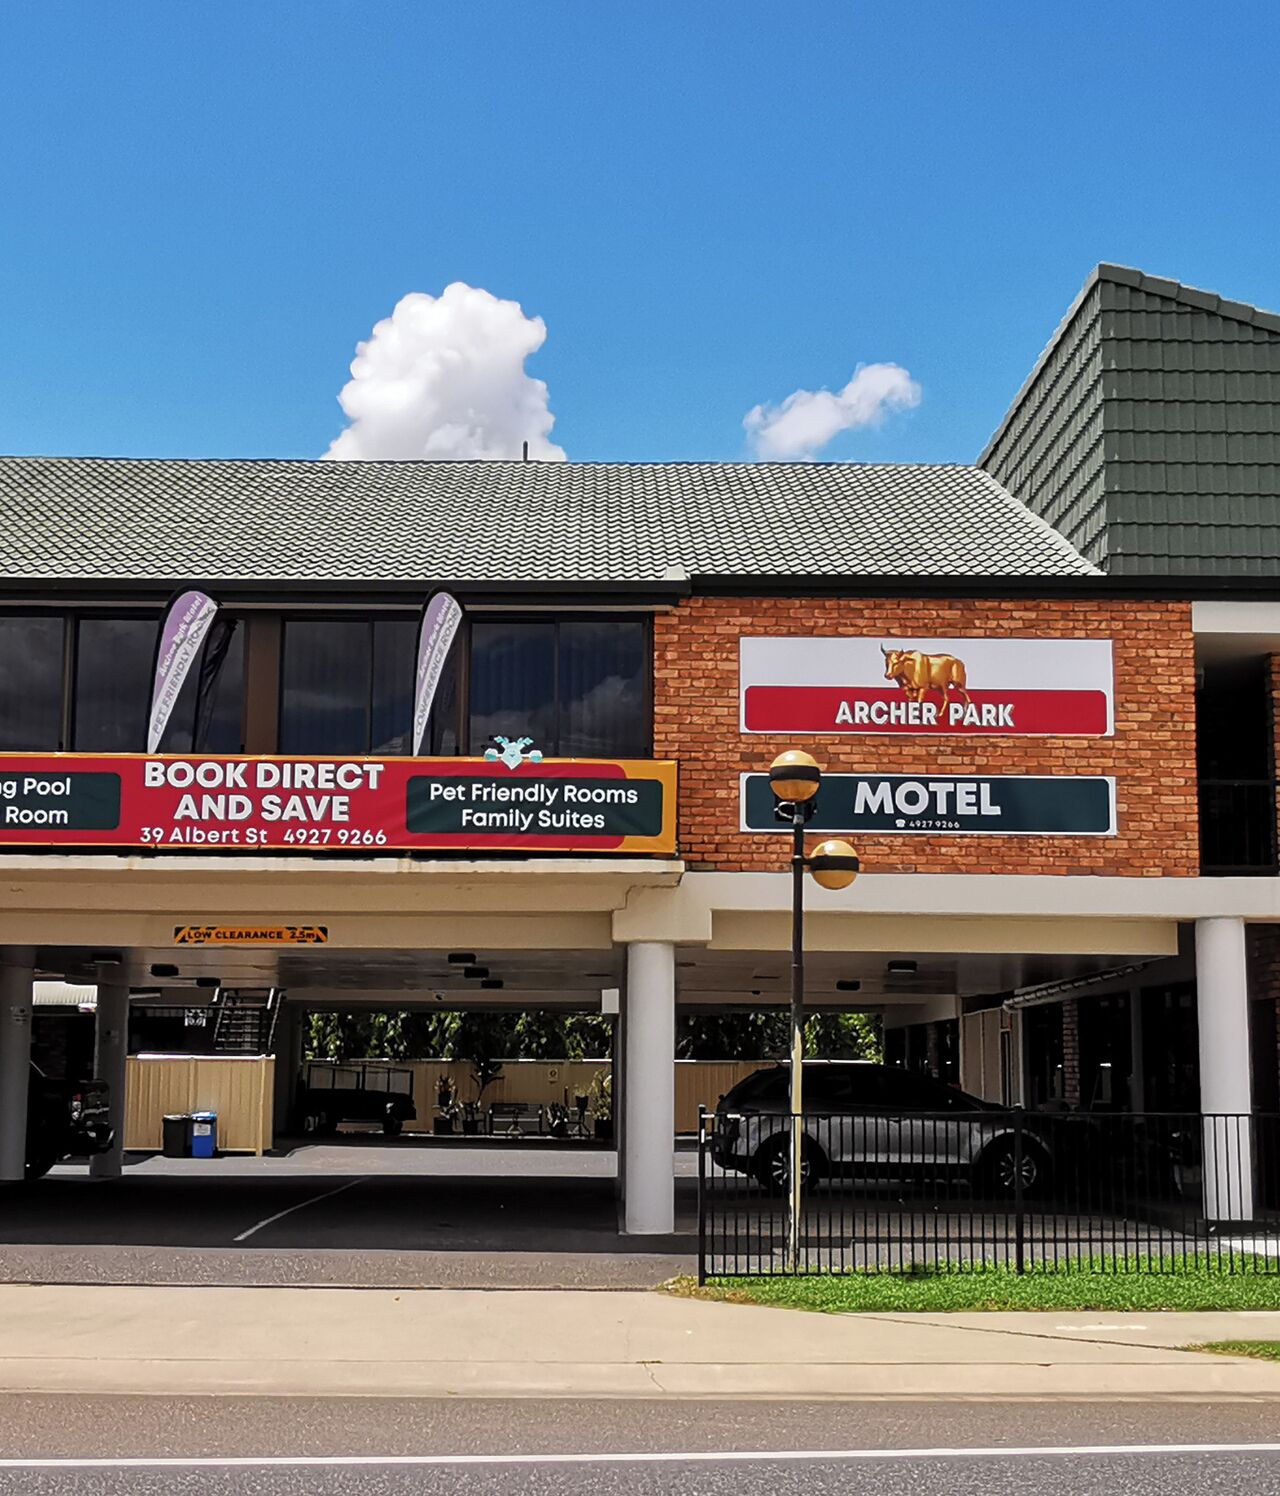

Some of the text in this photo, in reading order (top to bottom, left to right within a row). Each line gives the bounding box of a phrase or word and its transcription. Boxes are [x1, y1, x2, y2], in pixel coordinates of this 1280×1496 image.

[152, 710, 167, 734] PET
[162, 647, 191, 707] FRIENDLY
[835, 701, 1015, 727] ARCHER PARK
[24, 777, 71, 796] Pool
[145, 761, 385, 790] BOOK DIRECT
[430, 783, 638, 806] Pet Friendly Rooms
[854, 781, 1002, 816] MOTEL
[6, 806, 68, 824] Room
[174, 794, 350, 822] AND SAVE
[462, 809, 605, 831] Family Suites
[909, 820, 960, 829] 4927 9266
[140, 827, 387, 845] 39 Albert St 4927 9266
[187, 931, 212, 939] LOW
[215, 931, 283, 939] CLEARANCE
